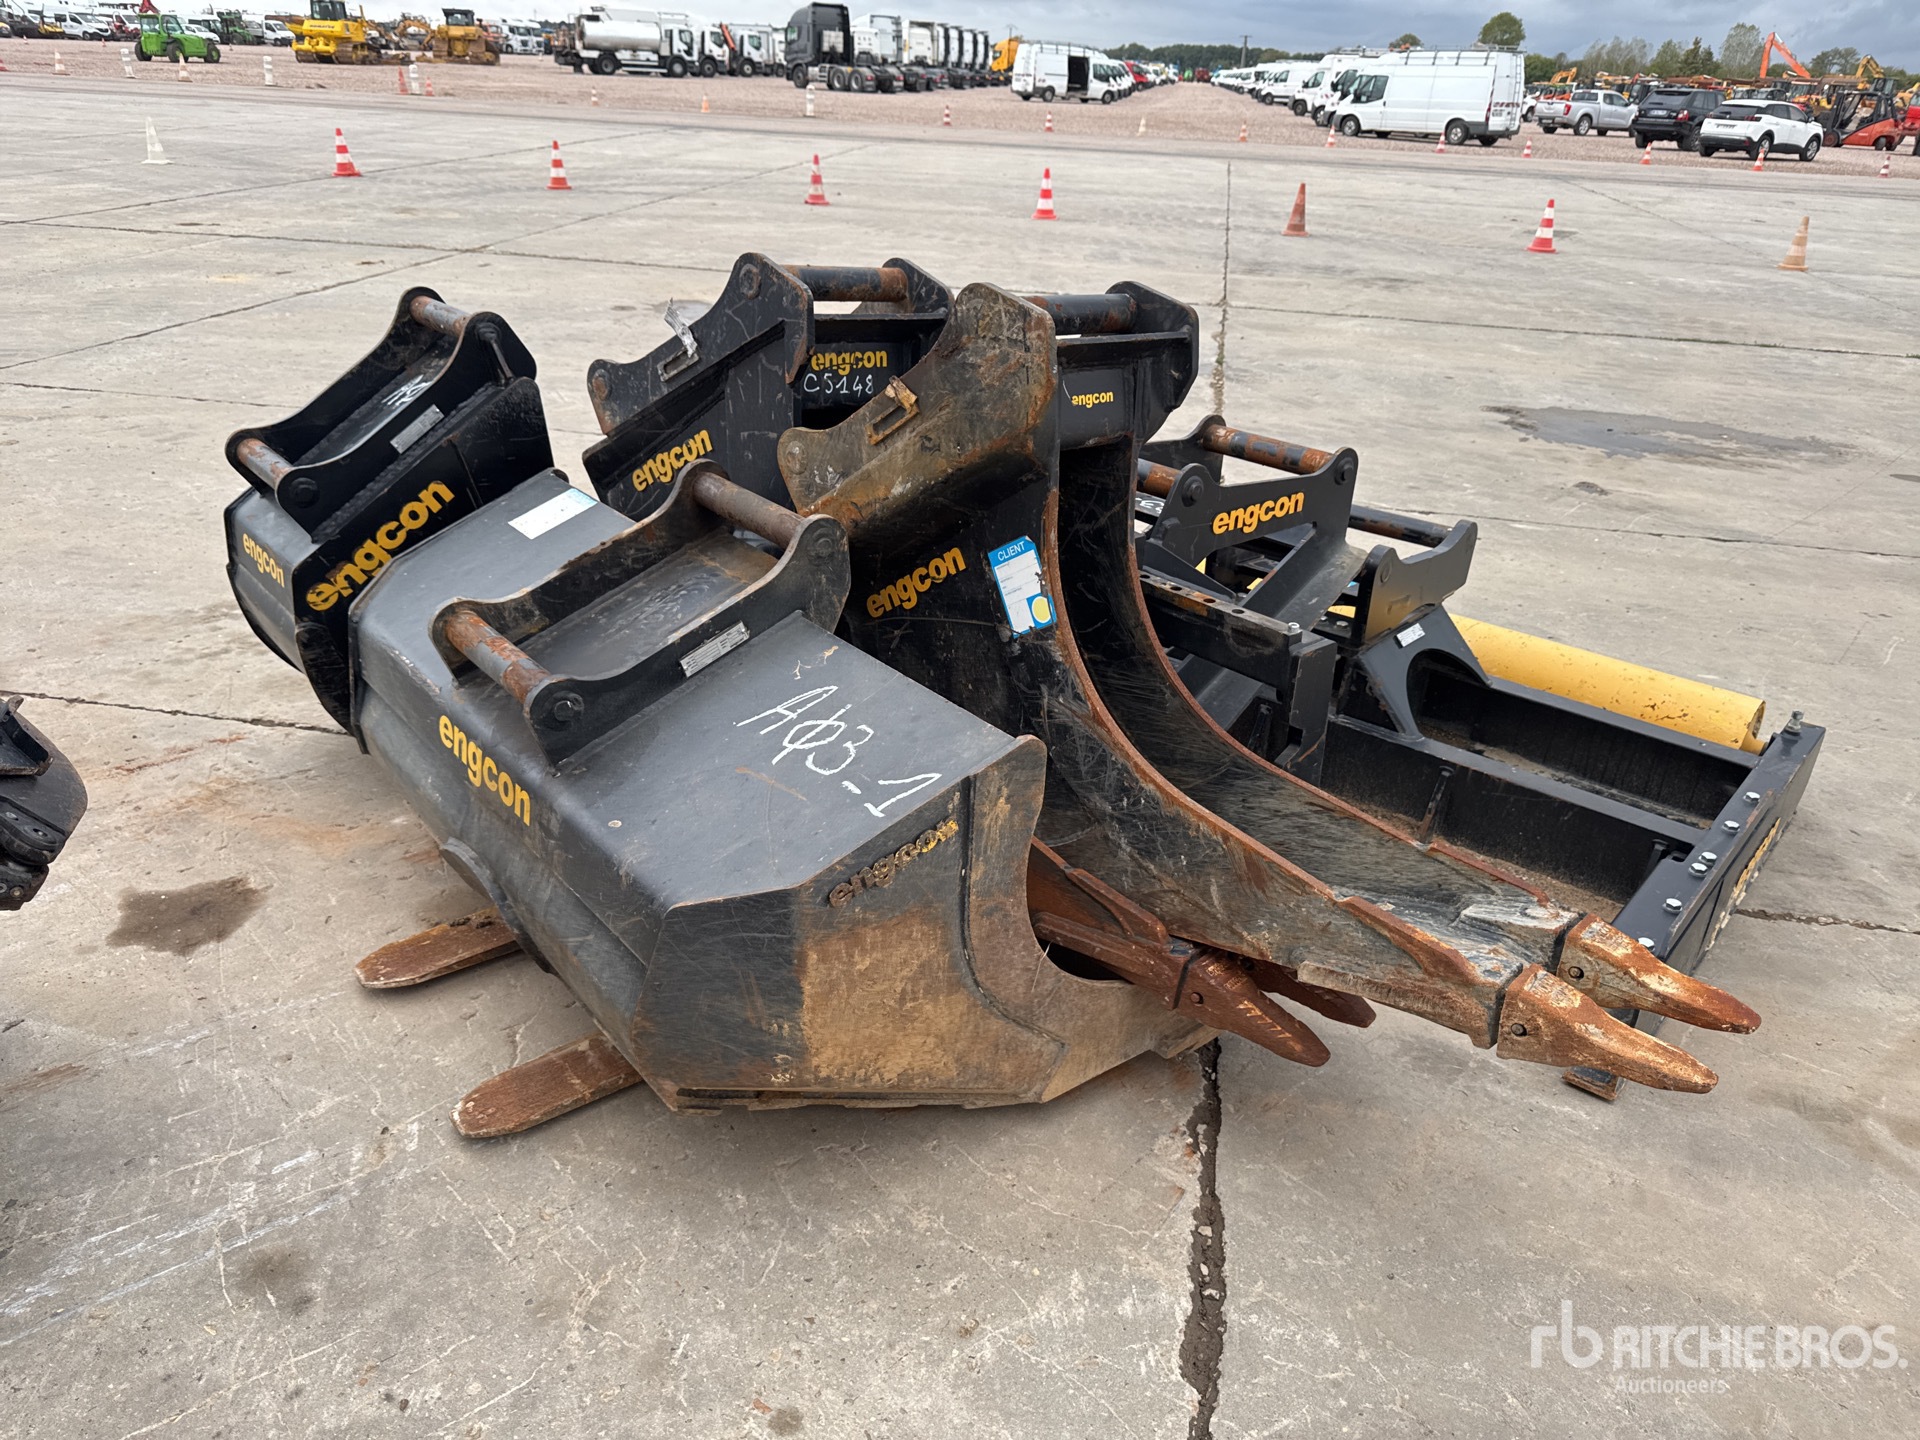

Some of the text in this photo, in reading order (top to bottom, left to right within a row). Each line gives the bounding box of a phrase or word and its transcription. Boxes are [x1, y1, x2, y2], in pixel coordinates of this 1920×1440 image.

[811, 351, 888, 376] engcon
[1071, 391, 1114, 408] engcon
[632, 429, 713, 492] engcon
[1212, 492, 1305, 534] engcon
[242, 532, 285, 588] engcon
[306, 480, 455, 611] engcon
[997, 541, 1026, 561] CLIENT
[866, 547, 966, 618] engcon
[439, 715, 531, 827] engcon
